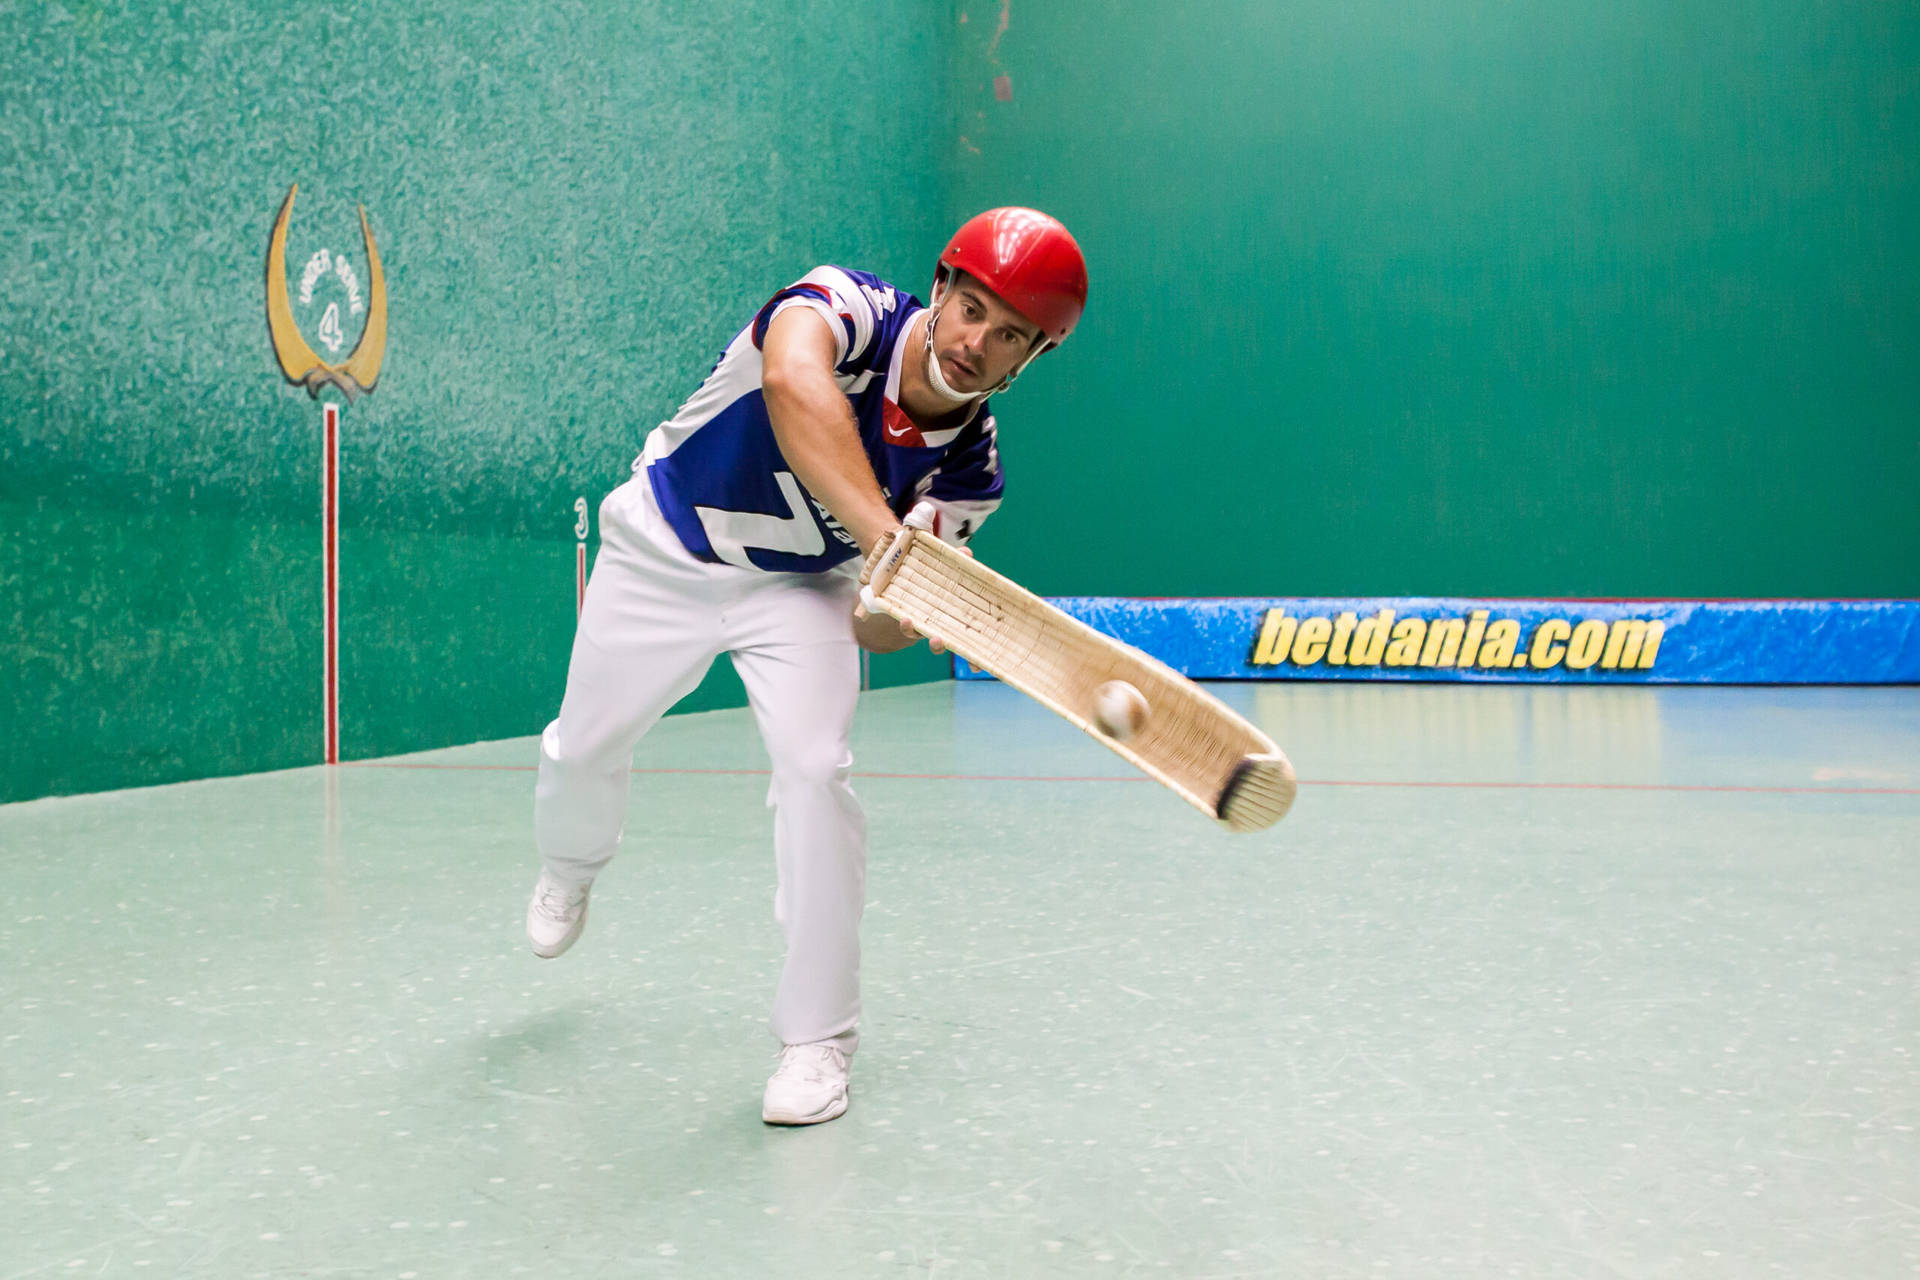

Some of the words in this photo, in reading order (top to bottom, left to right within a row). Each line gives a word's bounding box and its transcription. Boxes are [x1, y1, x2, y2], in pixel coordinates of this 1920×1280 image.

[319, 302, 343, 352] 4
[574, 496, 589, 539] 3
[1251, 606, 1666, 670] betdania.com
